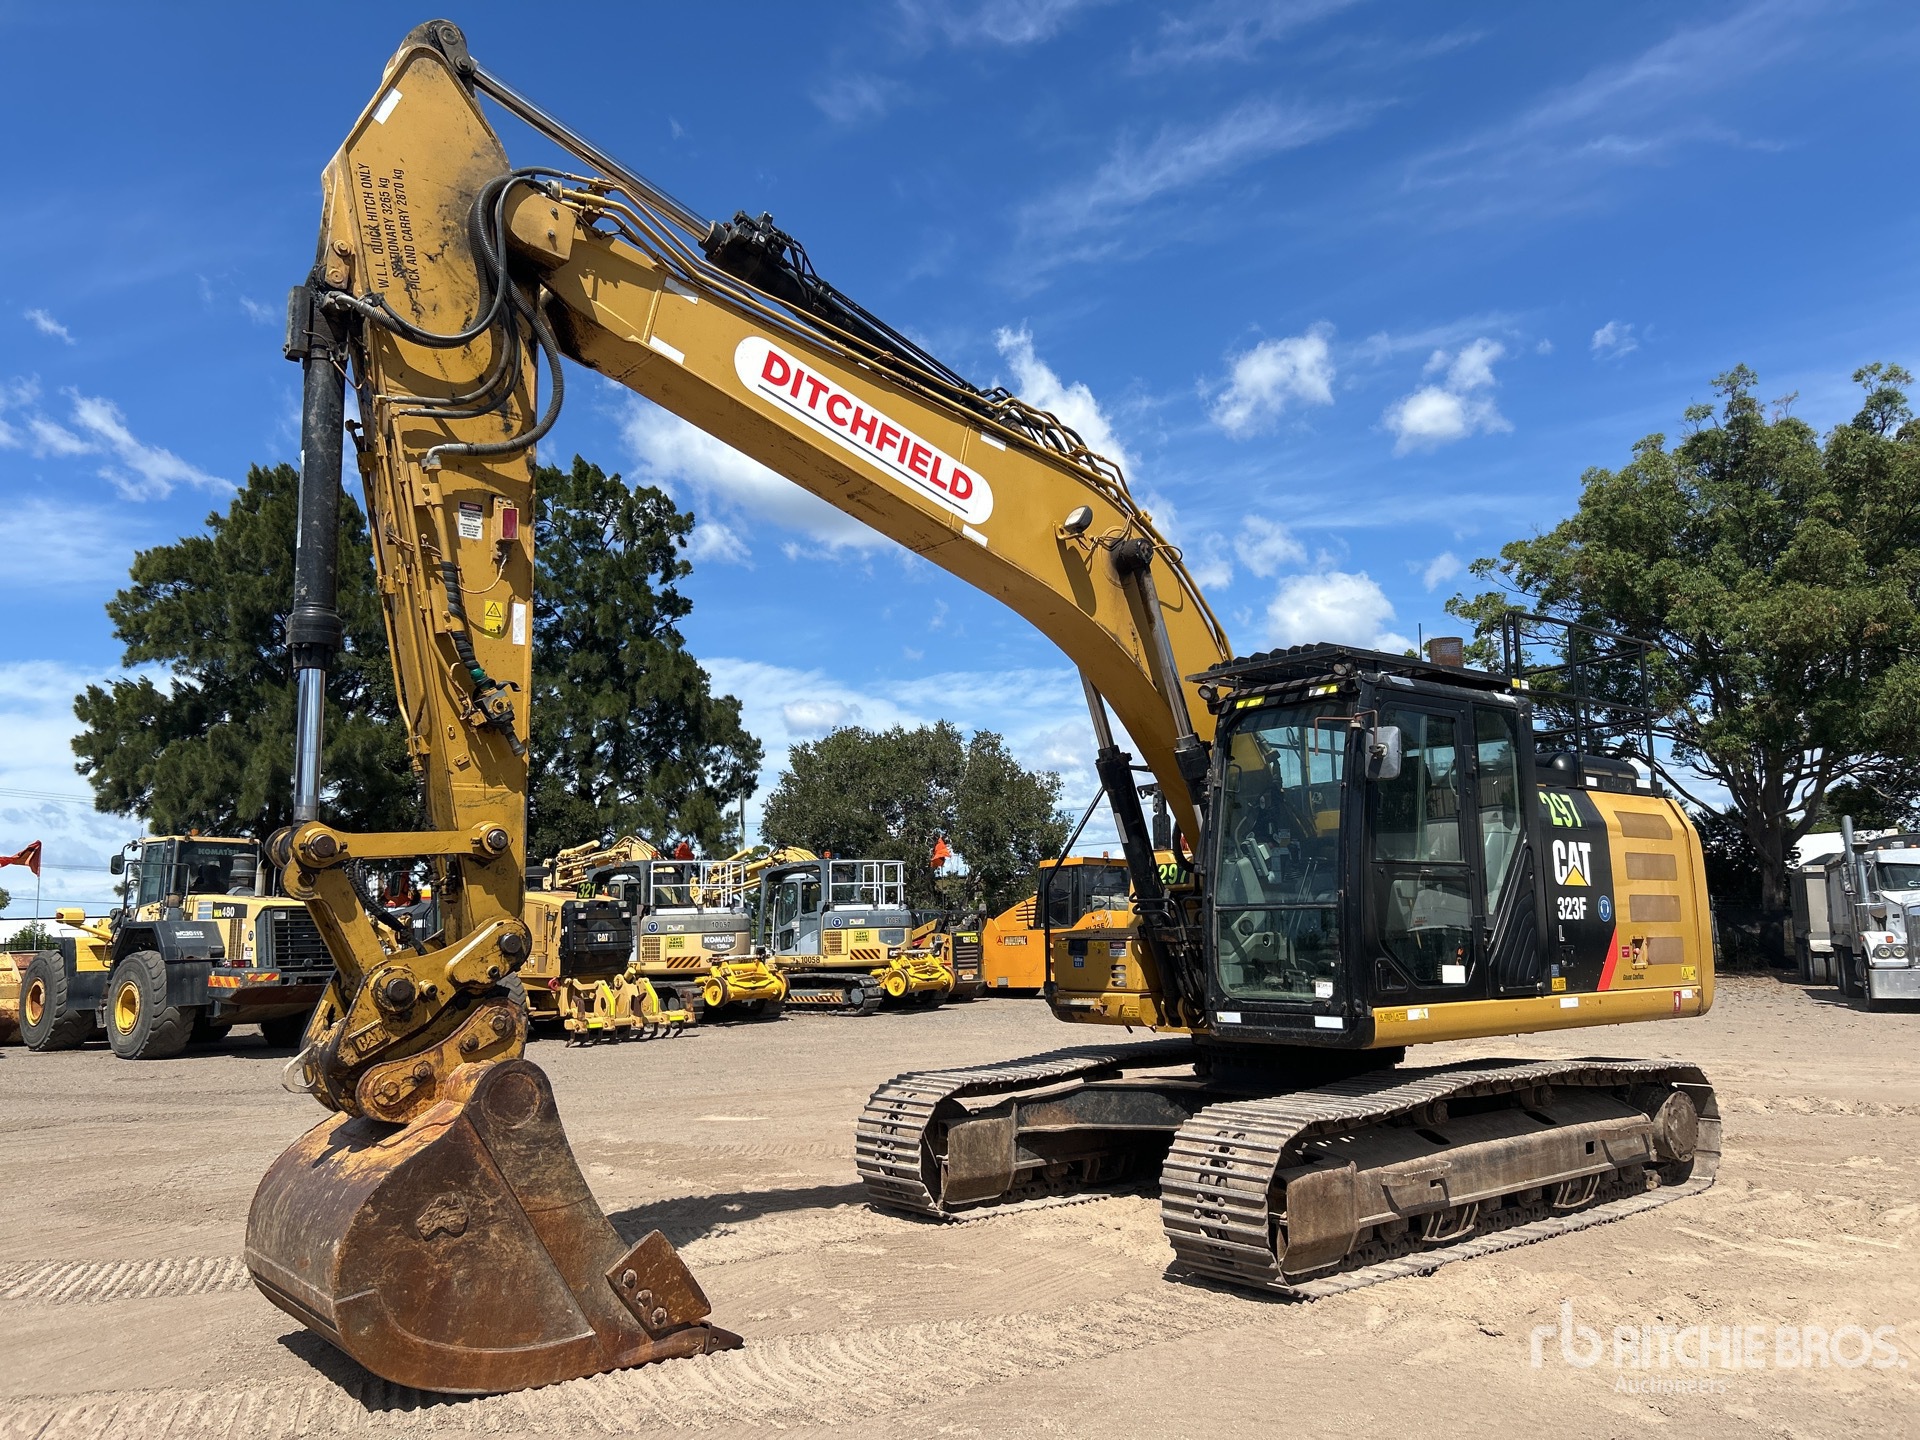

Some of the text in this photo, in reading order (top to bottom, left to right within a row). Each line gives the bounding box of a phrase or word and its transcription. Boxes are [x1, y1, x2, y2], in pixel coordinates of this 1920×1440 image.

[358, 162, 373, 189] ONLY
[378, 177, 390, 189] kg
[362, 191, 379, 222] HITCH
[379, 191, 394, 216] 3265
[368, 223, 384, 255] QUICK
[392, 168, 422, 291] PICK AND CARRY 2870 kg
[761, 350, 973, 501] DITCHFIELD
[1538, 791, 1582, 828] 297
[198, 847, 239, 856] KOMATSU
[1552, 839, 1592, 886] CAT
[1158, 863, 1188, 884] 297
[578, 882, 596, 899] 321
[1557, 896, 1587, 921] 323F
[597, 933, 609, 942] CAT
[704, 935, 736, 944] KOMATSU
[1558, 924, 1566, 942] L
[800, 956, 821, 964] 10058
[355, 1027, 387, 1052] CAT
